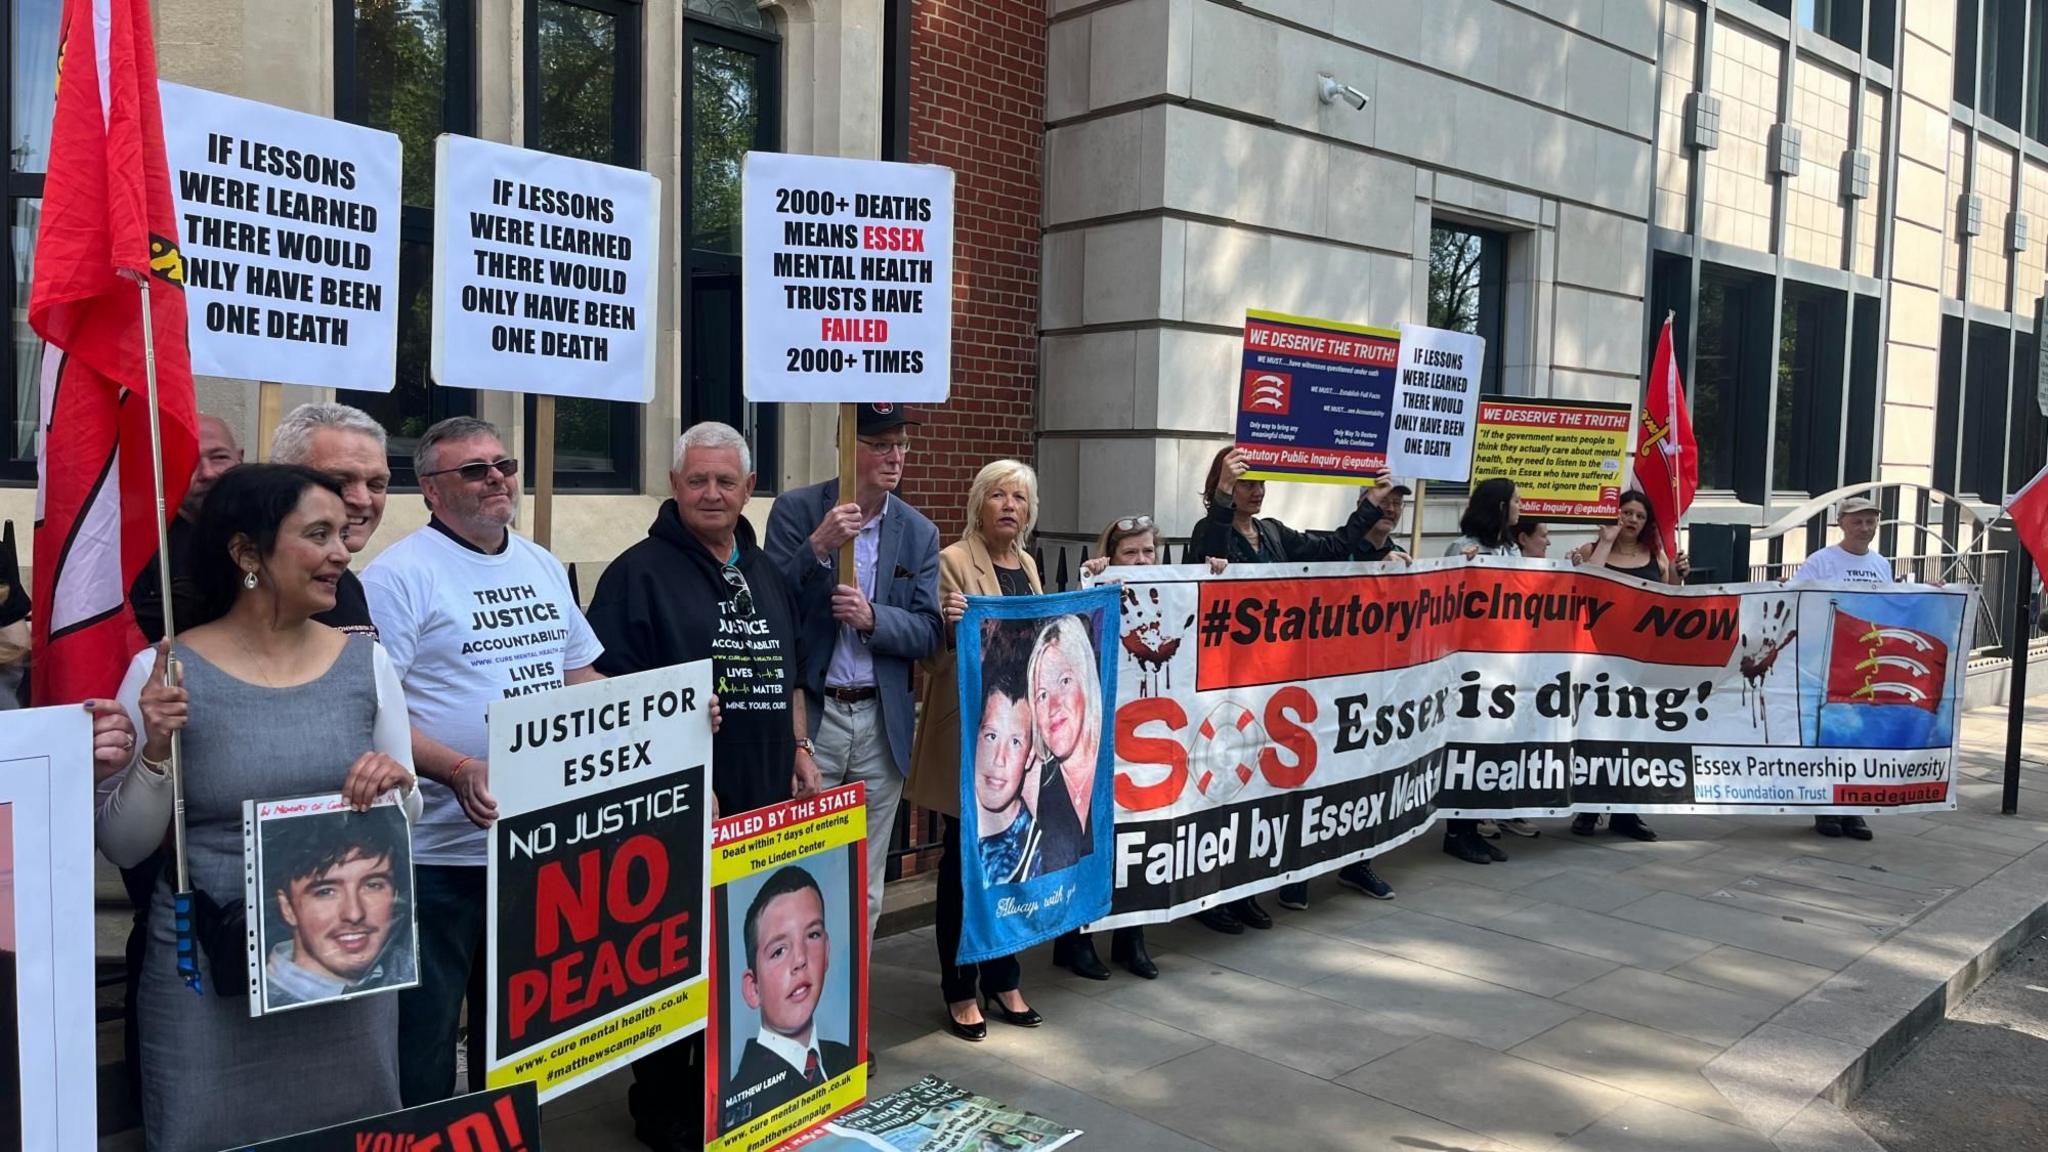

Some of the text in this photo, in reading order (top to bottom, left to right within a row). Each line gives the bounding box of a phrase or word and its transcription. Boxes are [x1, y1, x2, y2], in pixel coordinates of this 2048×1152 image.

[208, 133, 355, 190] IF LESSONS
[180, 170, 377, 233] WERE LEARNED
[493, 179, 614, 223] IF LESSONS
[776, 188, 931, 221] 2000+ DEATHS
[184, 214, 371, 271] THERE WOULD
[470, 212, 631, 260] WERE LEARNED
[785, 222, 924, 252] MEANS ESSEX
[474, 250, 626, 294] THERE WOULD
[774, 253, 932, 283] MENTAL HEALTH
[247, 266, 381, 311] HAVE BEEN
[784, 286, 922, 313] TRUSTS HAVE
[462, 285, 635, 330] ONLY HAVE BEEN
[207, 302, 348, 346] ONE DEATH
[822, 318, 888, 342] FAILED
[492, 326, 608, 361] ONE DEATH
[1250, 328, 1395, 362] WE DESERVE THE TRUTH!
[787, 348, 923, 373] 2000+ TIMES
[1414, 348, 1462, 370] IF LESSONS
[1403, 369, 1467, 392] WERE LEARNED
[1403, 392, 1463, 414] THERE WOULD
[1484, 408, 1626, 426] WE DESERVE THE TRUTH!
[1395, 414, 1465, 436] ONLY HAVE BEEN
[1492, 430, 1504, 439] the
[1506, 432, 1553, 441] government
[1556, 435, 1578, 443] wants
[1579, 436, 1605, 445] people
[1281, 451, 1309, 463] Public
[1311, 453, 1339, 467] Inquiry
[1405, 438, 1451, 456] ONE DEATH
[1476, 454, 1502, 464] health,
[1506, 455, 1523, 465] they
[1525, 457, 1545, 465] need
[1556, 457, 1577, 466] listen
[1501, 443, 1518, 453] they
[1520, 445, 1550, 454] actually
[1594, 448, 1620, 456] mental
[1475, 466, 1507, 475] families
[1519, 468, 1542, 476] Essex
[1544, 469, 1559, 477] who
[1561, 470, 1579, 479] have
[1581, 472, 1613, 480] suffered
[1552, 482, 1576, 491] ignore
[1543, 503, 1616, 514] Inquiry @eputnhs
[1847, 569, 1876, 578] TRUTH
[473, 584, 536, 605] TRUTH
[472, 603, 560, 630] JUSTICE
[719, 618, 769, 634] JUSTICE
[1633, 605, 1739, 641] NOW
[495, 652, 538, 663] CURE MENTAL
[509, 662, 554, 682] LIVES
[727, 668, 752, 678] LIVES
[753, 685, 782, 694] MATTER
[509, 686, 696, 753] JUSTICE FOR
[726, 702, 747, 710] MINE,
[749, 702, 771, 710] YOURS,
[1334, 687, 1449, 754] Essex
[1456, 671, 1516, 719] is
[1536, 672, 1713, 732] dying!
[564, 741, 652, 787] ESSEX
[1695, 755, 1945, 782] Essex Partnership University
[1696, 785, 1827, 800] NHS Foundation Trust
[1841, 787, 1939, 804] Inadequate
[509, 784, 690, 860] NO JUSTICE
[768, 809, 786, 828] BY
[790, 802, 815, 820] THE
[820, 790, 856, 812] STATE
[1115, 812, 1239, 889] Failed
[1250, 808, 1290, 868] by
[1301, 791, 1386, 847] Essex
[1445, 749, 1565, 791] Health
[722, 814, 849, 859] Dead within 7 days of entering
[751, 840, 825, 870] The Linden Center
[535, 834, 669, 958] NO
[996, 896, 1038, 918] Always
[1044, 885, 1063, 907] with
[509, 911, 689, 1040] PEACE
[515, 992, 688, 1075] www. cure mental health .co.uk
[546, 1023, 662, 1081] #matthewscampaign
[726, 1071, 787, 1108] MATTHEW LEAHY
[724, 1075, 851, 1147] www. cure mental health .co.uk
[747, 1103, 831, 1152] #matthewscampaign
